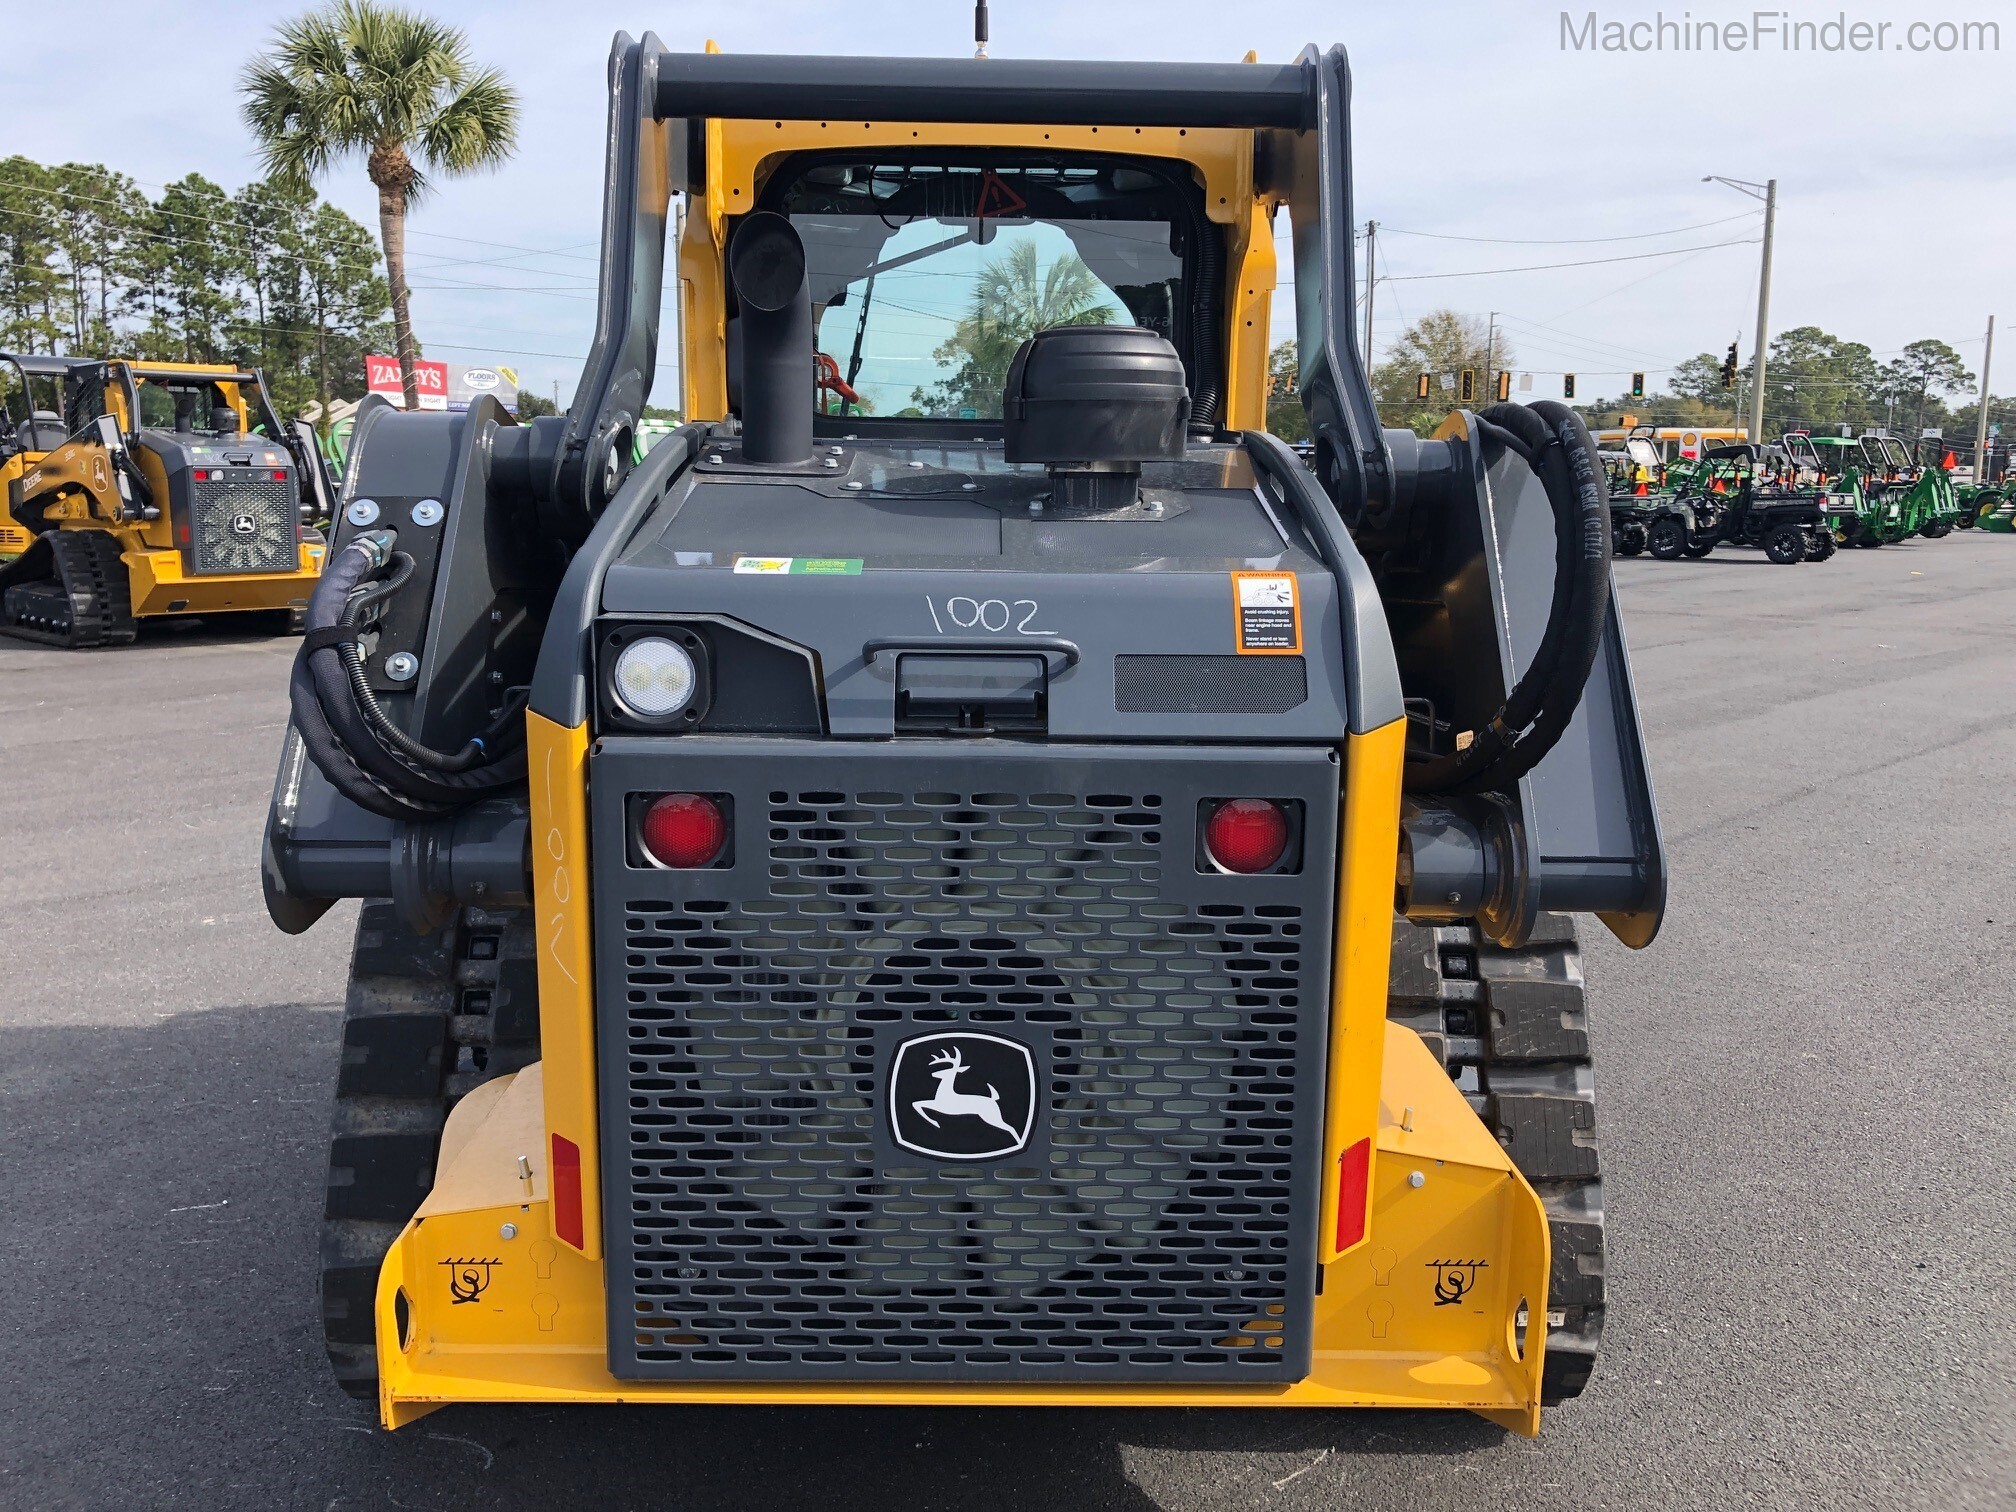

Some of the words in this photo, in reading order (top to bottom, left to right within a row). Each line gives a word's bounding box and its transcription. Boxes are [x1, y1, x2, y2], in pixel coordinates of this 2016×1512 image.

[372, 365, 442, 390] ZAXY'S
[467, 372, 496, 381] FLOORS
[22, 469, 43, 493] DEERE
[925, 594, 1059, 635] 1002
